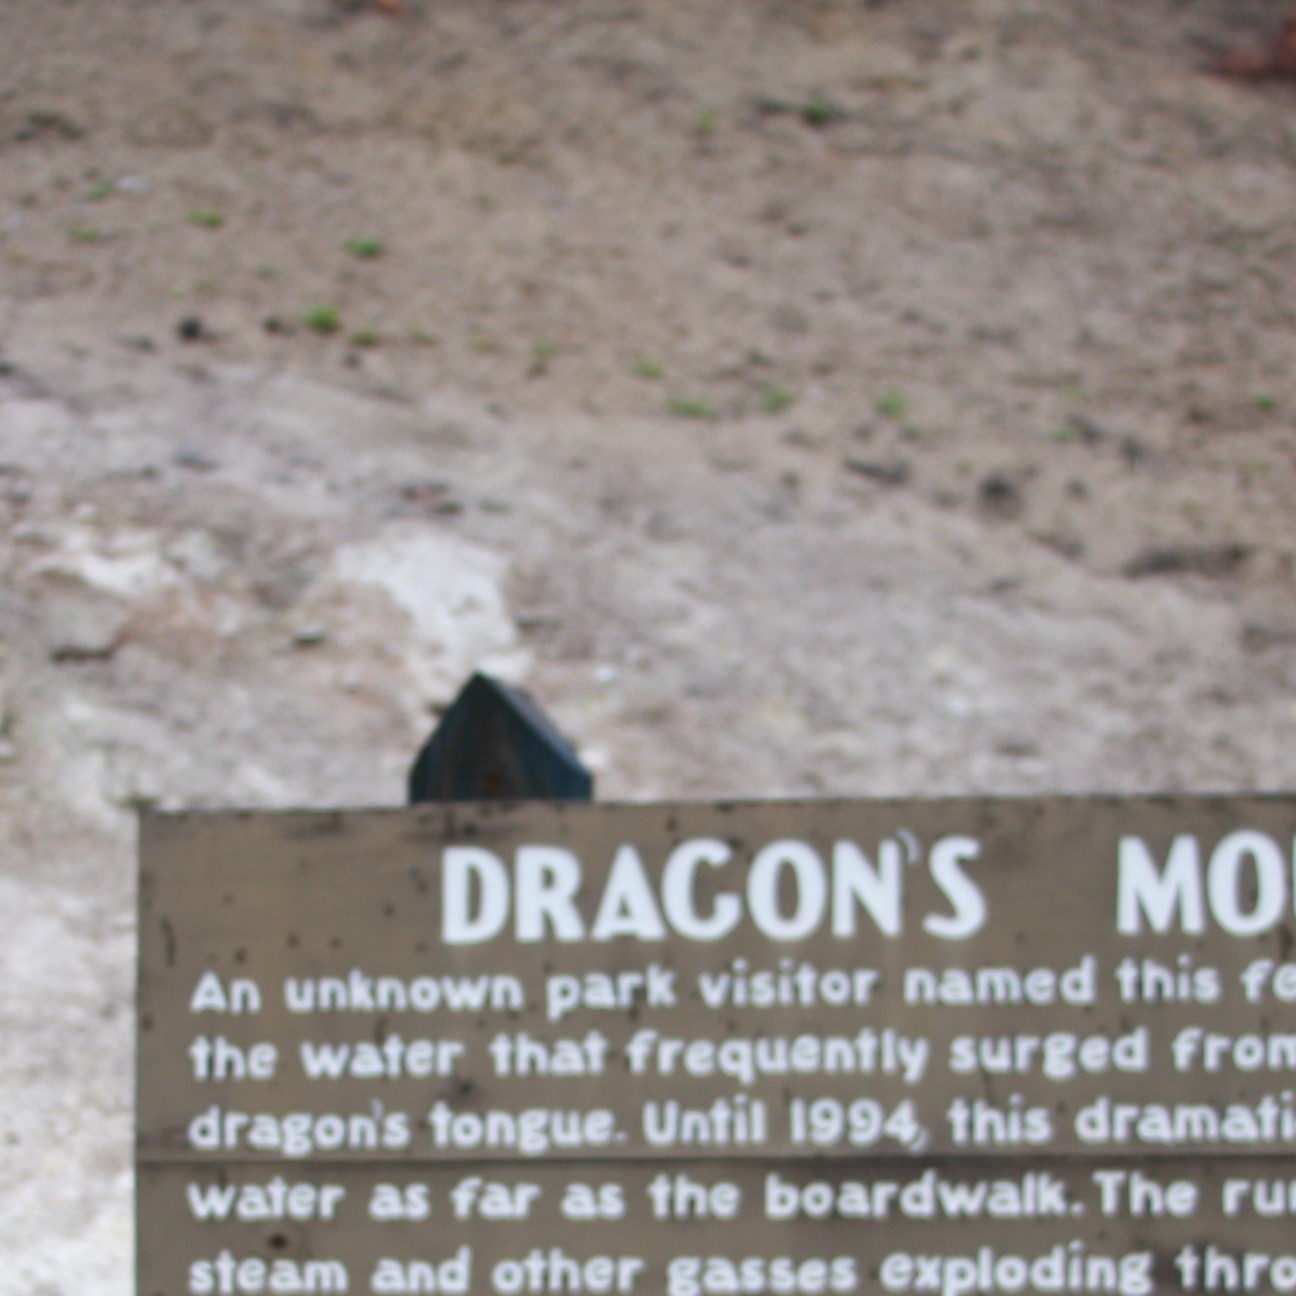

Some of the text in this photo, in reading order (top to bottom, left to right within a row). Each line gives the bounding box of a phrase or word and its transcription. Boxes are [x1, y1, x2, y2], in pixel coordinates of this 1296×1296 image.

[440, 832, 988, 947] DRAGON'S
[189, 971, 263, 1014] An
[283, 968, 525, 1014] unknown
[545, 964, 676, 1022] park
[698, 957, 878, 1008] visitor
[903, 954, 1096, 1006] named
[1115, 953, 1222, 1004] this
[188, 1035, 279, 1081] the
[299, 1033, 466, 1080] water
[488, 1031, 608, 1076] that
[626, 1028, 929, 1086] frequently
[949, 1026, 1149, 1081] surged
[187, 1101, 411, 1159] dragon's
[428, 1101, 626, 1157] tongue.
[642, 1093, 767, 1148] Until
[946, 1094, 1053, 1144] this
[186, 1176, 345, 1222] water
[367, 1182, 431, 1221] as
[450, 1176, 541, 1220] far
[560, 1182, 626, 1220] as
[647, 1174, 740, 1219] the
[764, 1171, 1084, 1220] boardwalk.
[1093, 1170, 1198, 1217] The
[187, 1249, 350, 1296] steam
[369, 1245, 472, 1296] and
[490, 1247, 645, 1296] other
